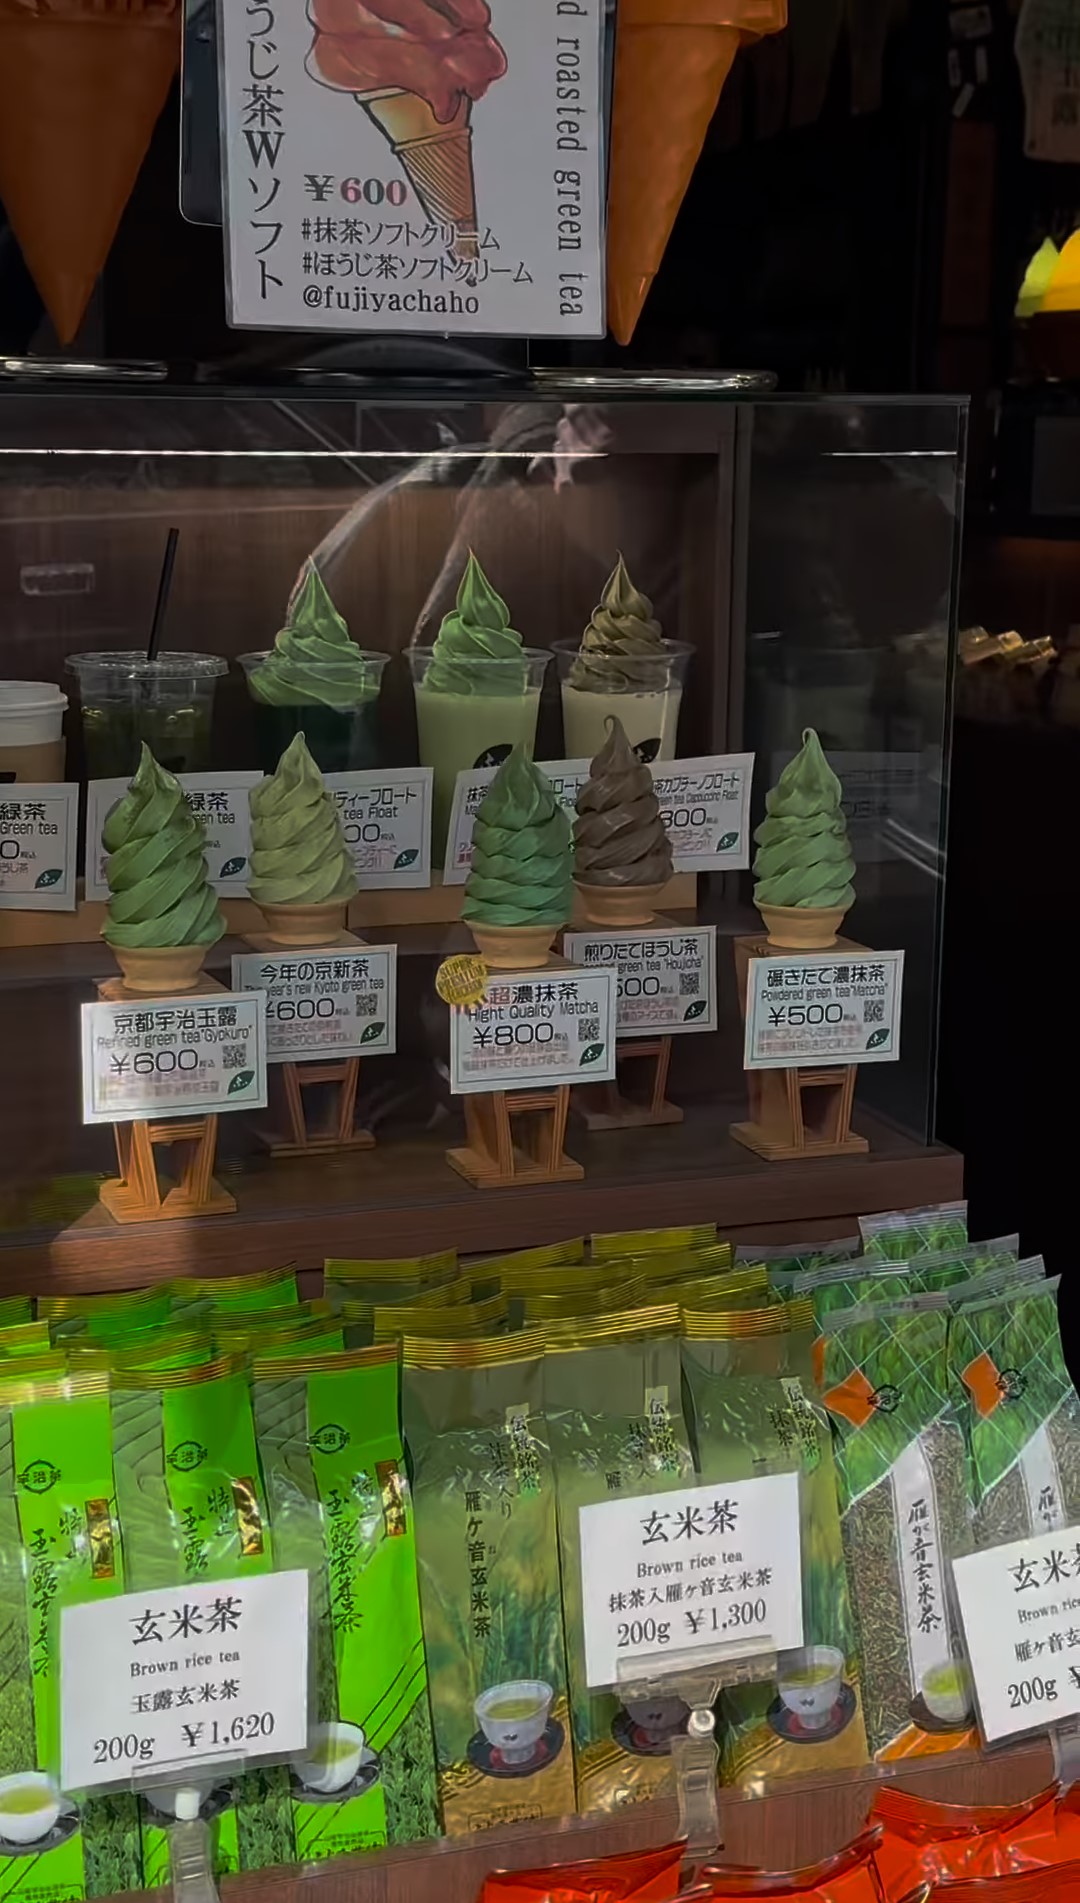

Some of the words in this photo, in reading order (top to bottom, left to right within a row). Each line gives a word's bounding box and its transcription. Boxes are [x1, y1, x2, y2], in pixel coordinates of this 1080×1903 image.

[556, 36, 588, 152] roasted
[303, 174, 407, 206] ¥600
[552, 168, 585, 252] green
[300, 217, 501, 250] #抹茶ソフトクリーム
[302, 250, 534, 285] #ほうじ茶ソフトクリーム
[302, 285, 480, 315] @fujiyachaho
[558, 272, 589, 317] tea
[218, 812, 235, 824] tea
[344, 809, 363, 820] tea
[368, 806, 398, 819] Float
[0, 821, 33, 834] Green
[39, 821, 58, 835] tea
[584, 938, 698, 961] 煎りたてほうじ茶
[260, 959, 369, 984] 今年の京新茶
[646, 961, 660, 971] tea
[767, 964, 885, 988] 碾きたて濃抹茶
[295, 983, 312, 995] new
[314, 982, 340, 997] Kyoto
[341, 979, 367, 993] green
[369, 978, 384, 990] tea
[489, 982, 578, 1006] 超濃抹茶
[761, 986, 804, 1002] Powdered
[806, 987, 832, 1001] green
[113, 1005, 238, 1034] 京都宇治玉露
[509, 1003, 555, 1020] Quality
[560, 1000, 599, 1015] Matcha
[768, 1004, 843, 1027] ¥500
[144, 1032, 178, 1048] green
[473, 1022, 554, 1048] ¥800
[110, 1049, 199, 1075] ¥600
[639, 1499, 740, 1547] 玄米茶
[636, 1560, 684, 1580] Brown
[689, 1554, 717, 1571] rice
[721, 1550, 744, 1565] tea
[129, 1596, 244, 1647] 玄米茶
[617, 1617, 671, 1648] 200g
[684, 1598, 767, 1635] ¥1,300
[1018, 1604, 1059, 1624] Brown
[129, 1657, 180, 1679] Brown
[185, 1653, 213, 1671] rice
[218, 1648, 241, 1665] tea
[131, 1679, 241, 1715] 玉露玄米茶
[1007, 1676, 1059, 1708] 200g
[93, 1734, 156, 1765] 200g
[180, 1710, 276, 1749] ¥1,620
